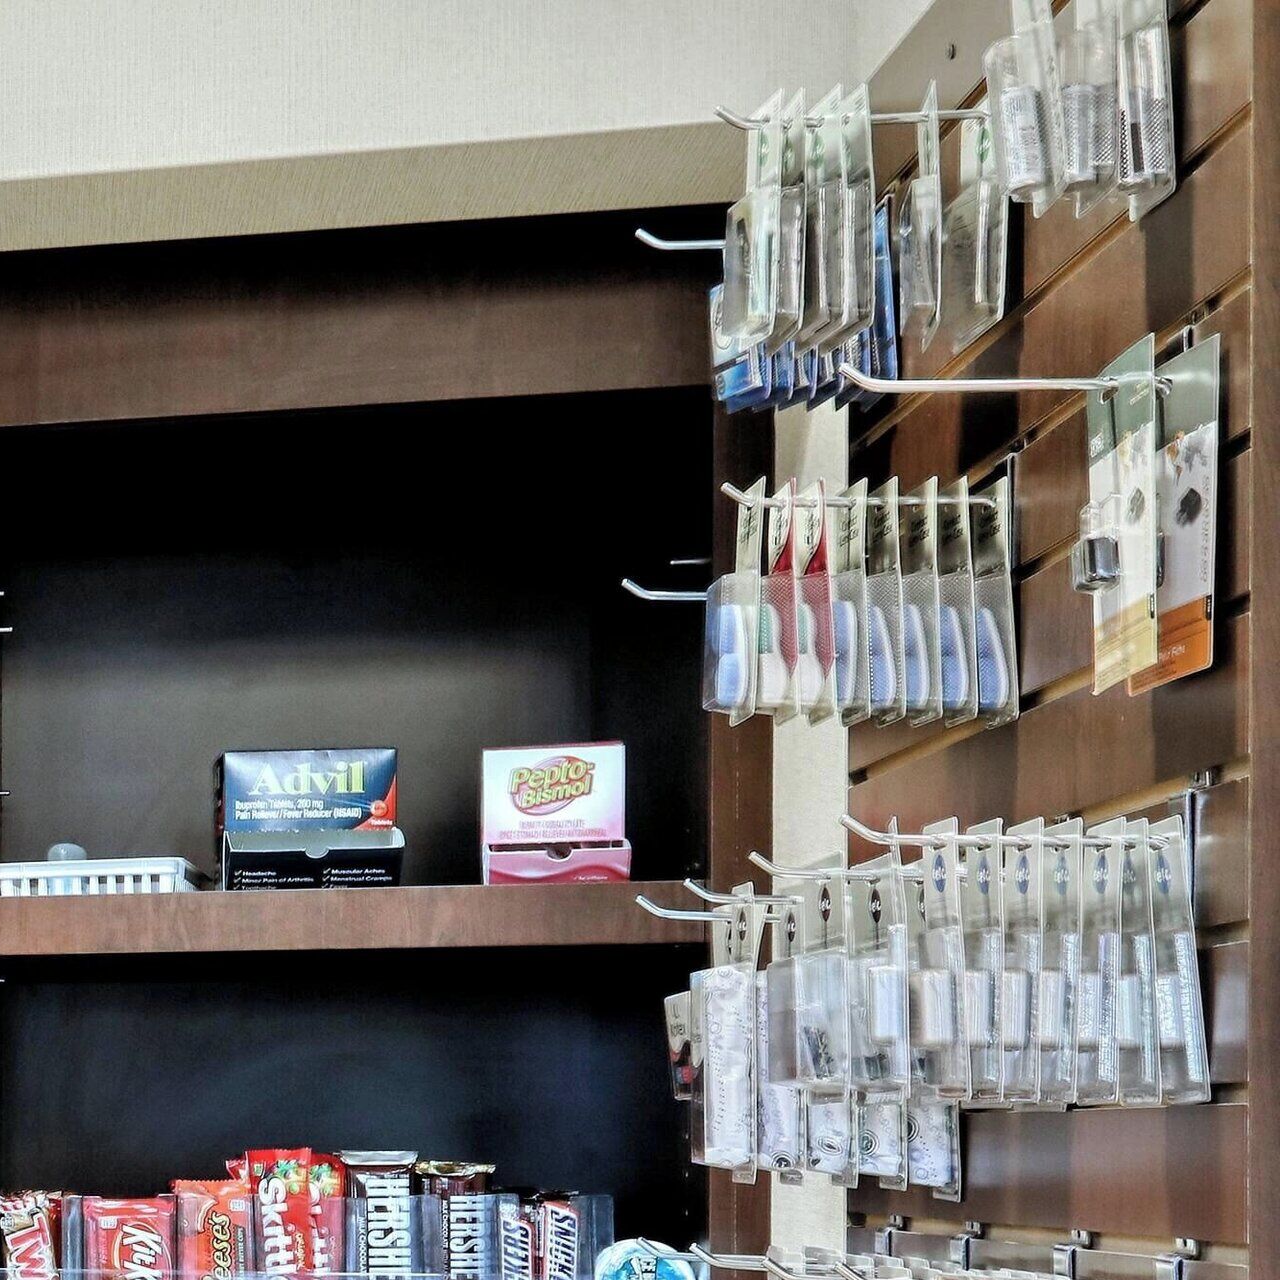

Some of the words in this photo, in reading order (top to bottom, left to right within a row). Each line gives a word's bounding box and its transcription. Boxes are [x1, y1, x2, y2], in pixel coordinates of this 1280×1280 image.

[248, 761, 366, 796] Advil
[520, 775, 592, 809] Bismol
[235, 800, 268, 812] Ibuprofen
[312, 801, 323, 812] mg
[235, 810, 251, 820] Pain
[304, 808, 332, 819] Reducer
[442, 1214, 450, 1249] CHOCOLATE
